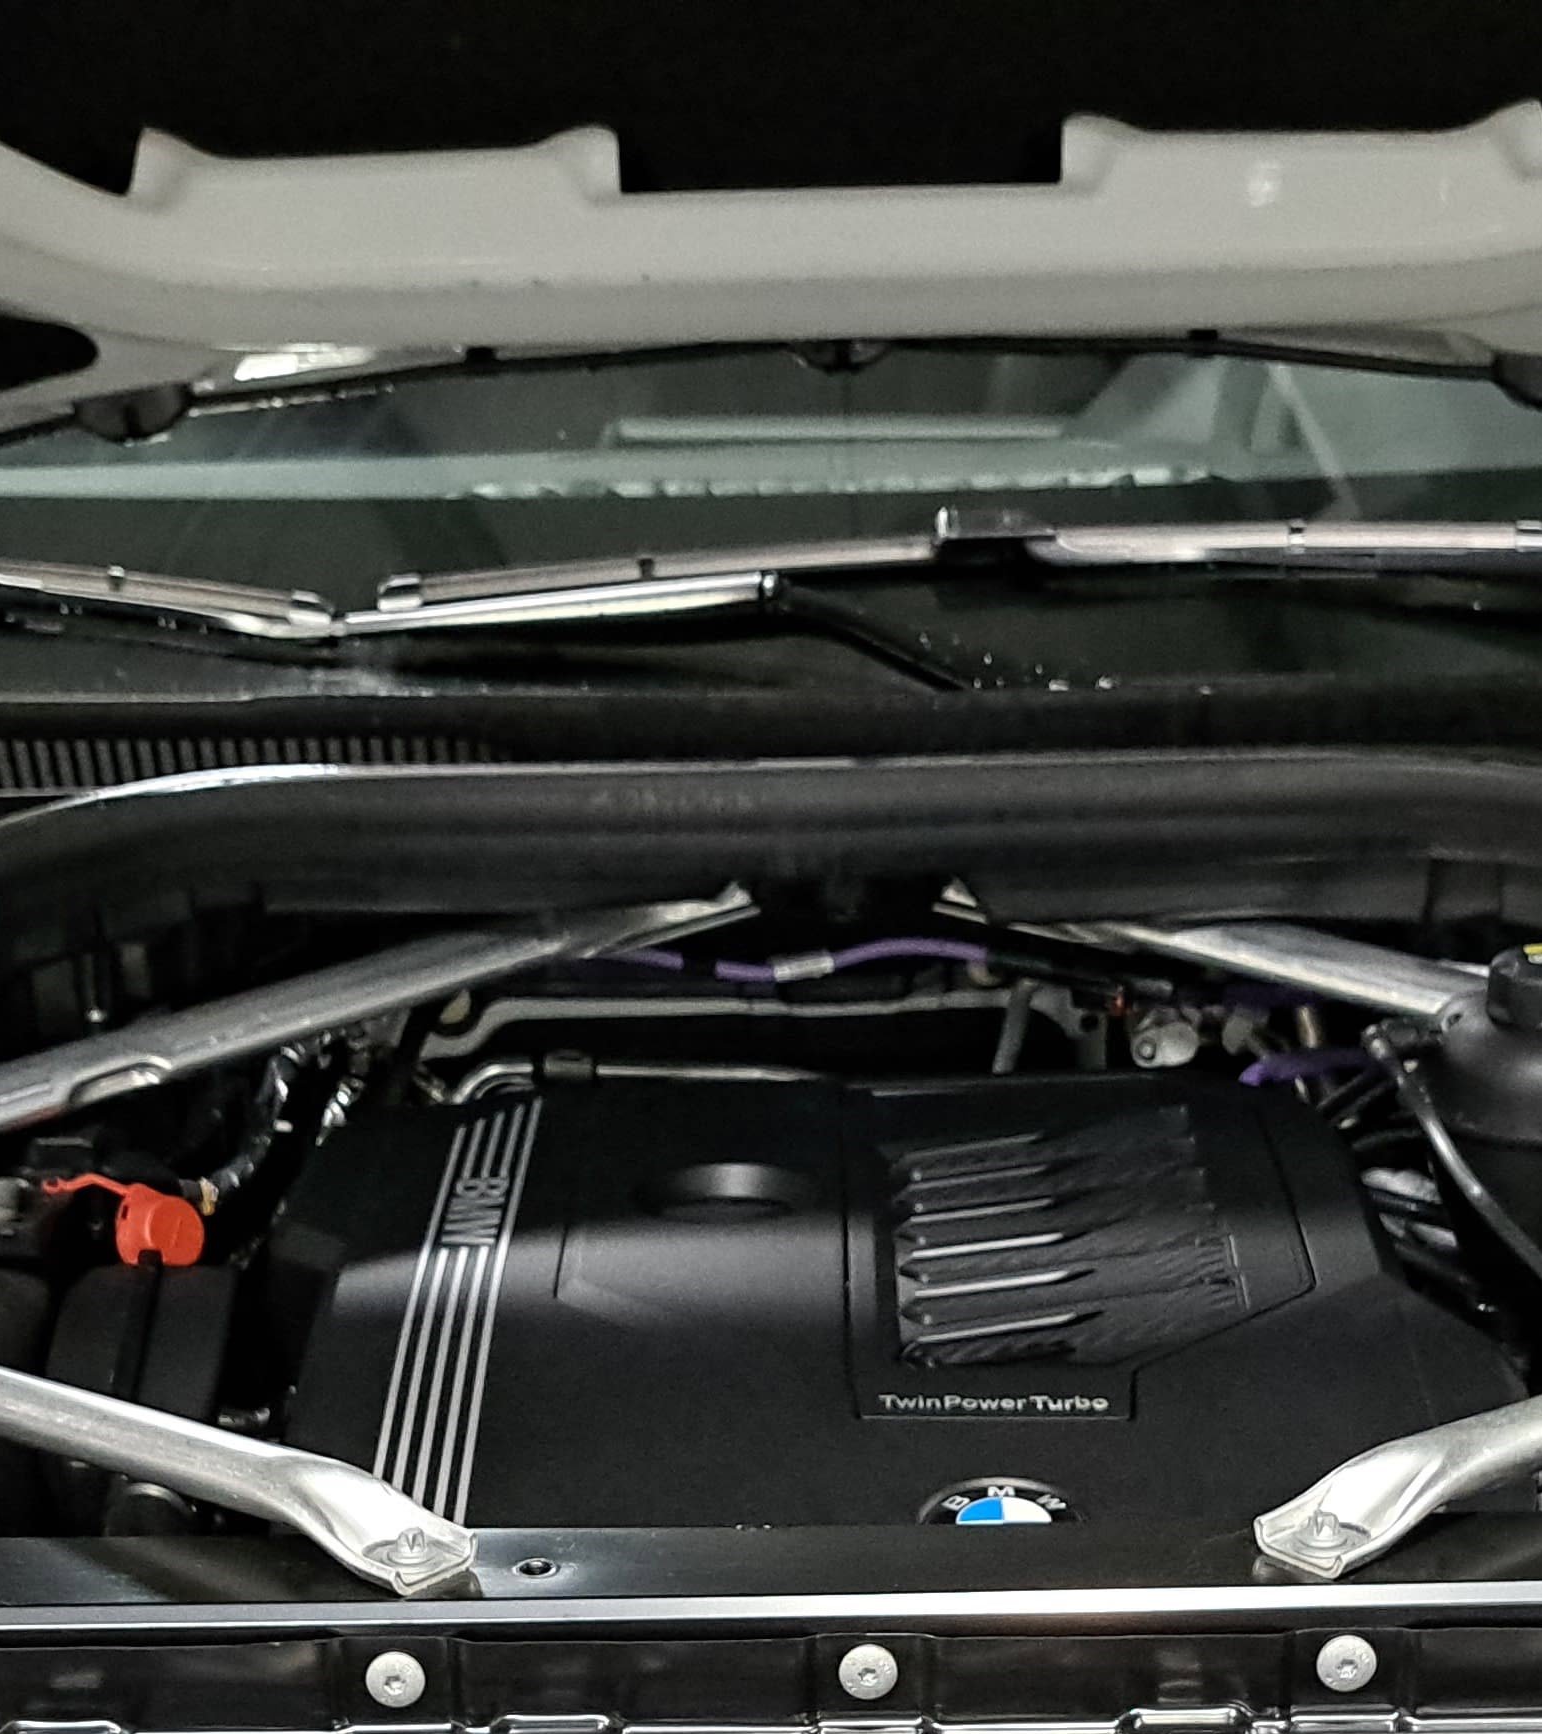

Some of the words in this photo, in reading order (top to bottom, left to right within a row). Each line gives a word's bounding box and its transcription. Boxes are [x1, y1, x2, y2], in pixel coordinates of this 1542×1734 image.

[440, 1177, 509, 1245] BMW
[1028, 1394, 1110, 1412] Turbo
[941, 1485, 1067, 1511] BMW
